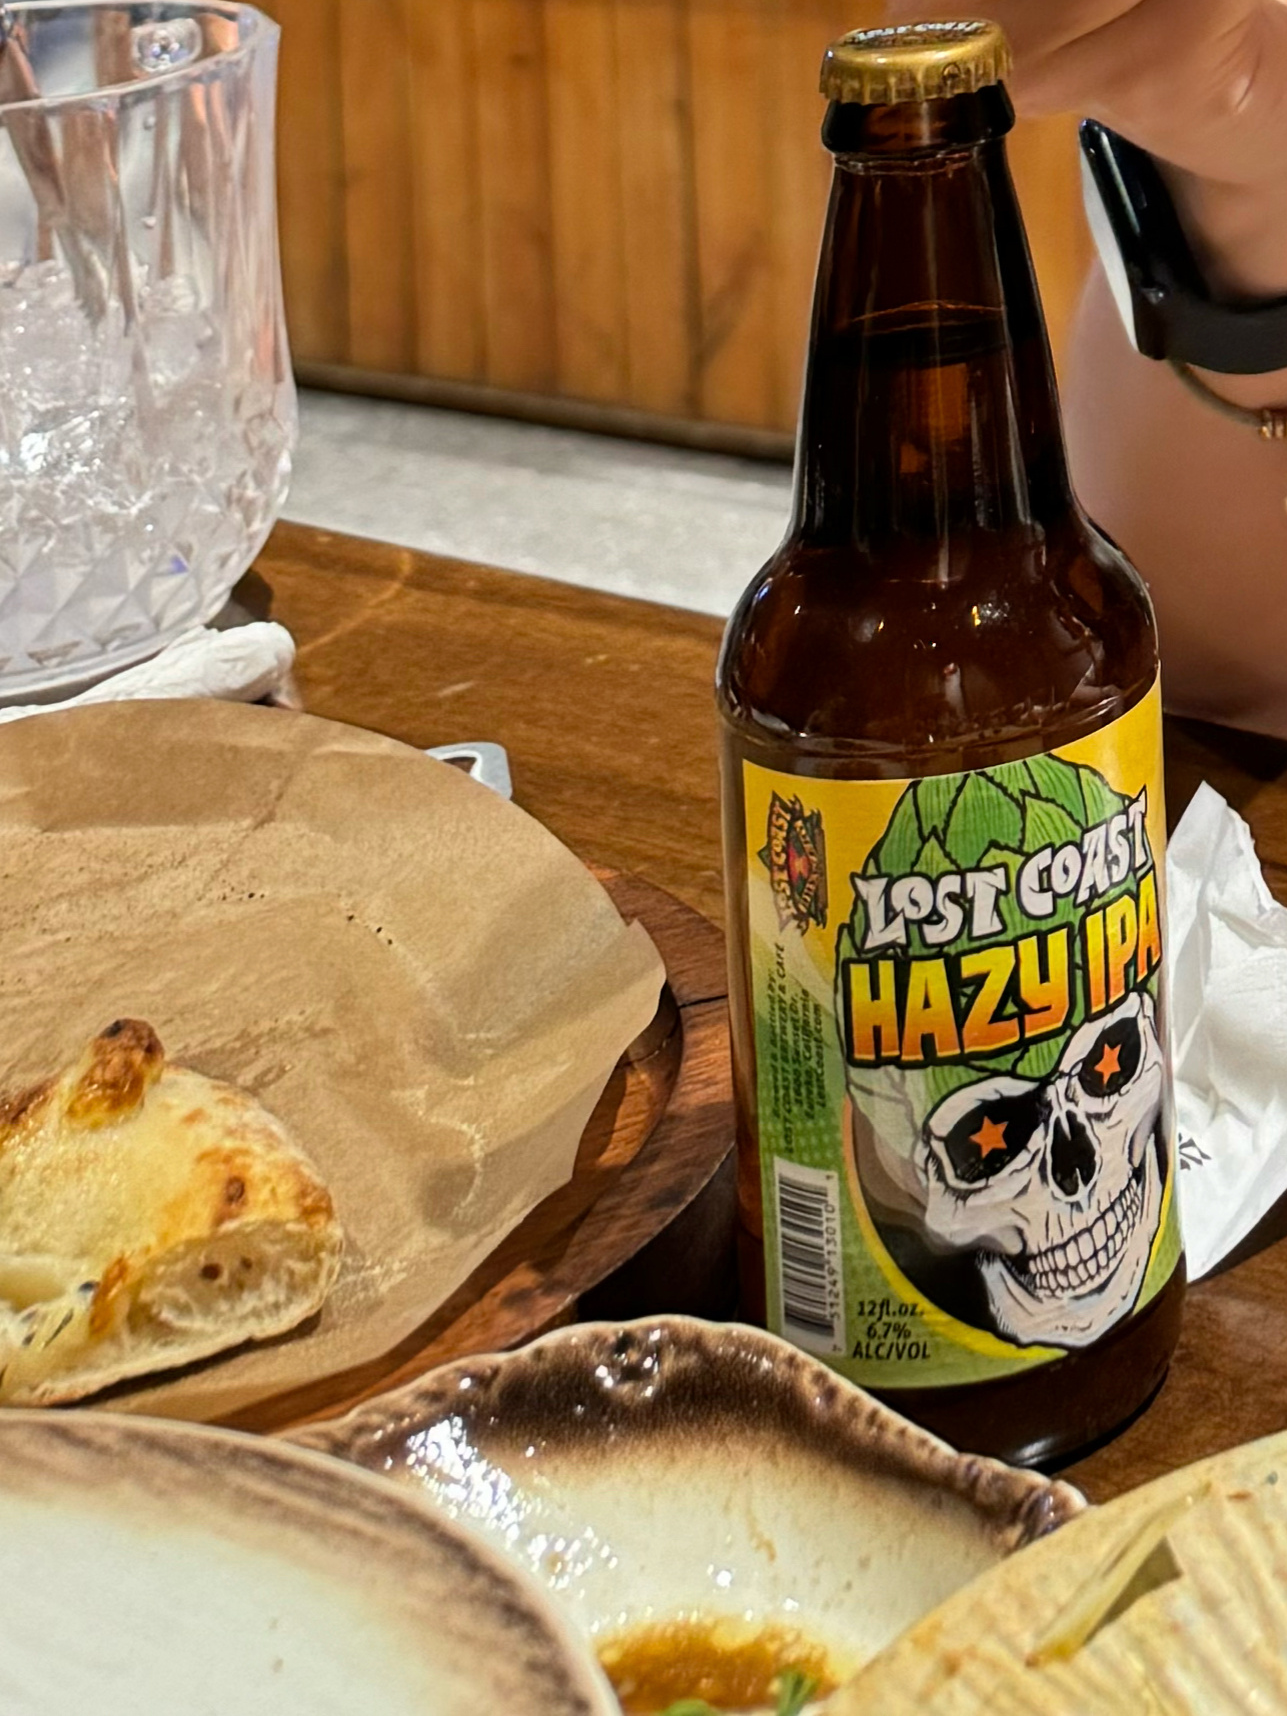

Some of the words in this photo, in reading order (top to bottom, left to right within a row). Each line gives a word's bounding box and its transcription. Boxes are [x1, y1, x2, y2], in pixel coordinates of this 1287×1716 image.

[771, 801, 791, 866] COAST
[852, 866, 1008, 952] LOST
[1019, 786, 1150, 917] COAST
[850, 927, 1069, 1061] HAZY
[1085, 870, 1162, 1014] IPA
[782, 1115, 794, 1154] LOST
[824, 1203, 837, 1257] 13010
[827, 1266, 840, 1320] 51249
[852, 1340, 931, 1361] ALC/VOL
[866, 1322, 912, 1340] 6.7%
